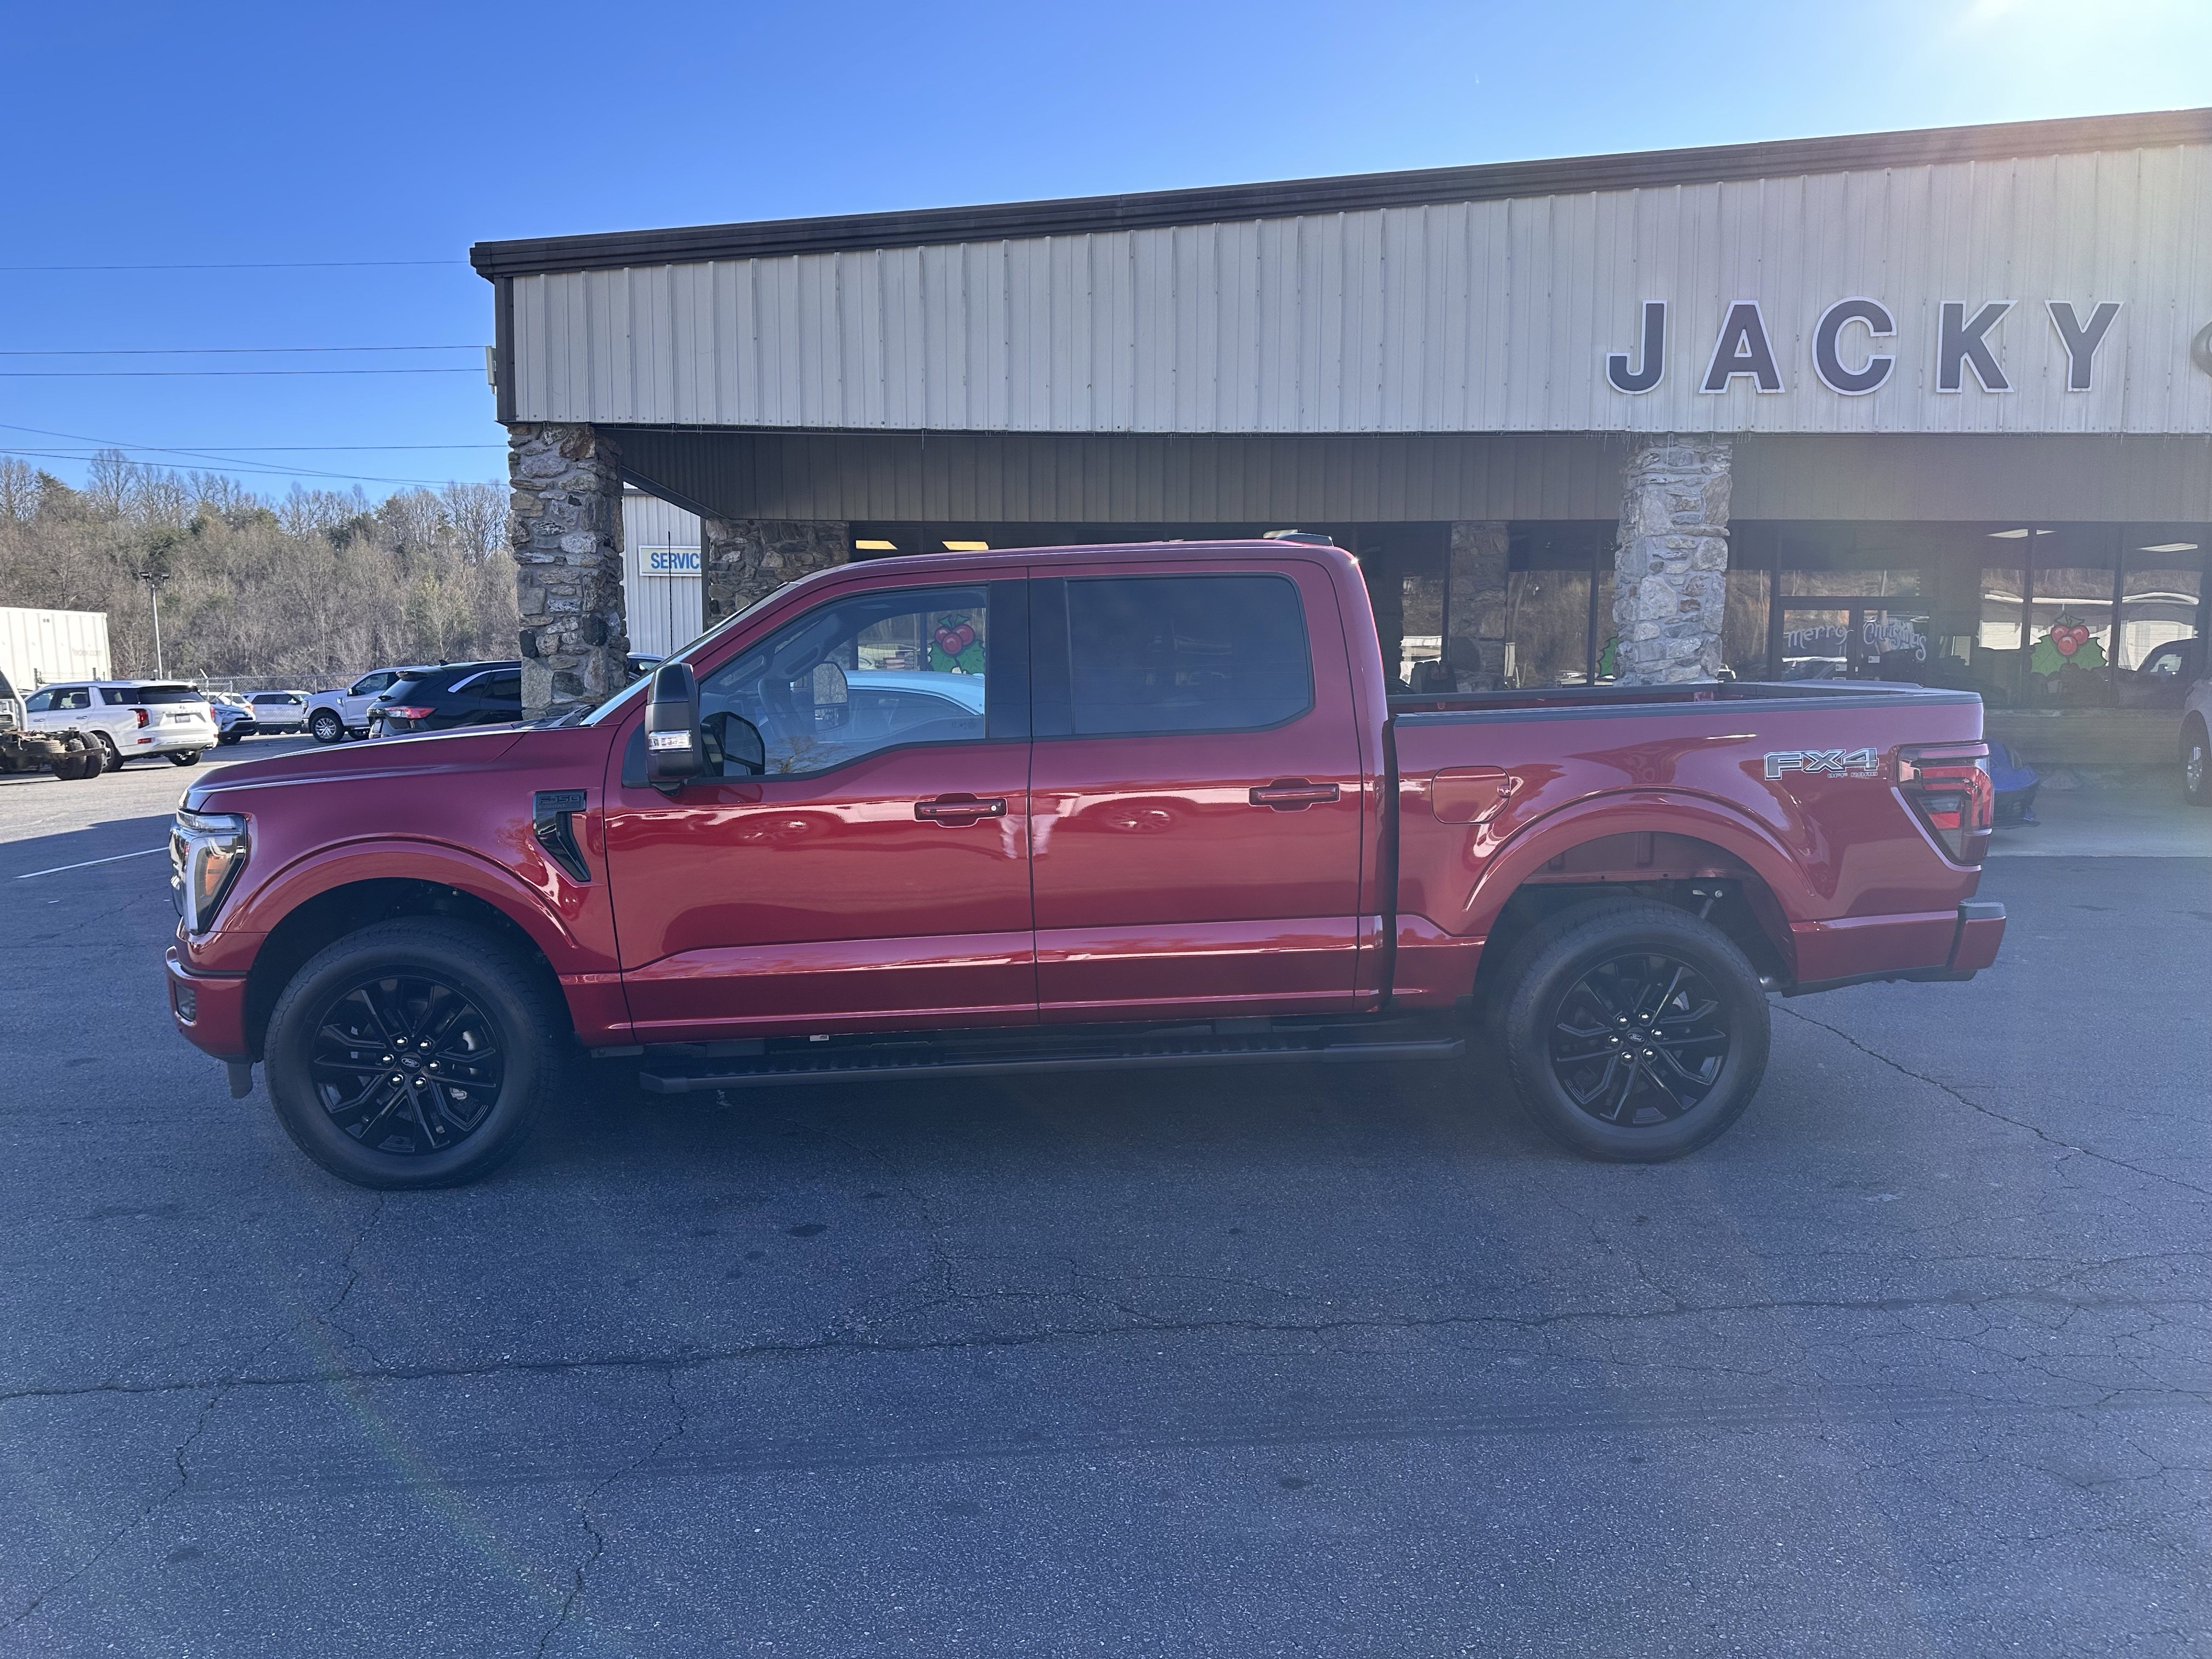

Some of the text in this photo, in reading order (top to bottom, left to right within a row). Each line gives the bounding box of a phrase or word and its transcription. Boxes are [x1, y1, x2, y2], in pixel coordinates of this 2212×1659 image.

[1606, 296, 2125, 396] JACKY
[651, 552, 702, 569] SERVIC
[1764, 748, 1879, 781] FX4
[539, 794, 581, 804] F-150
